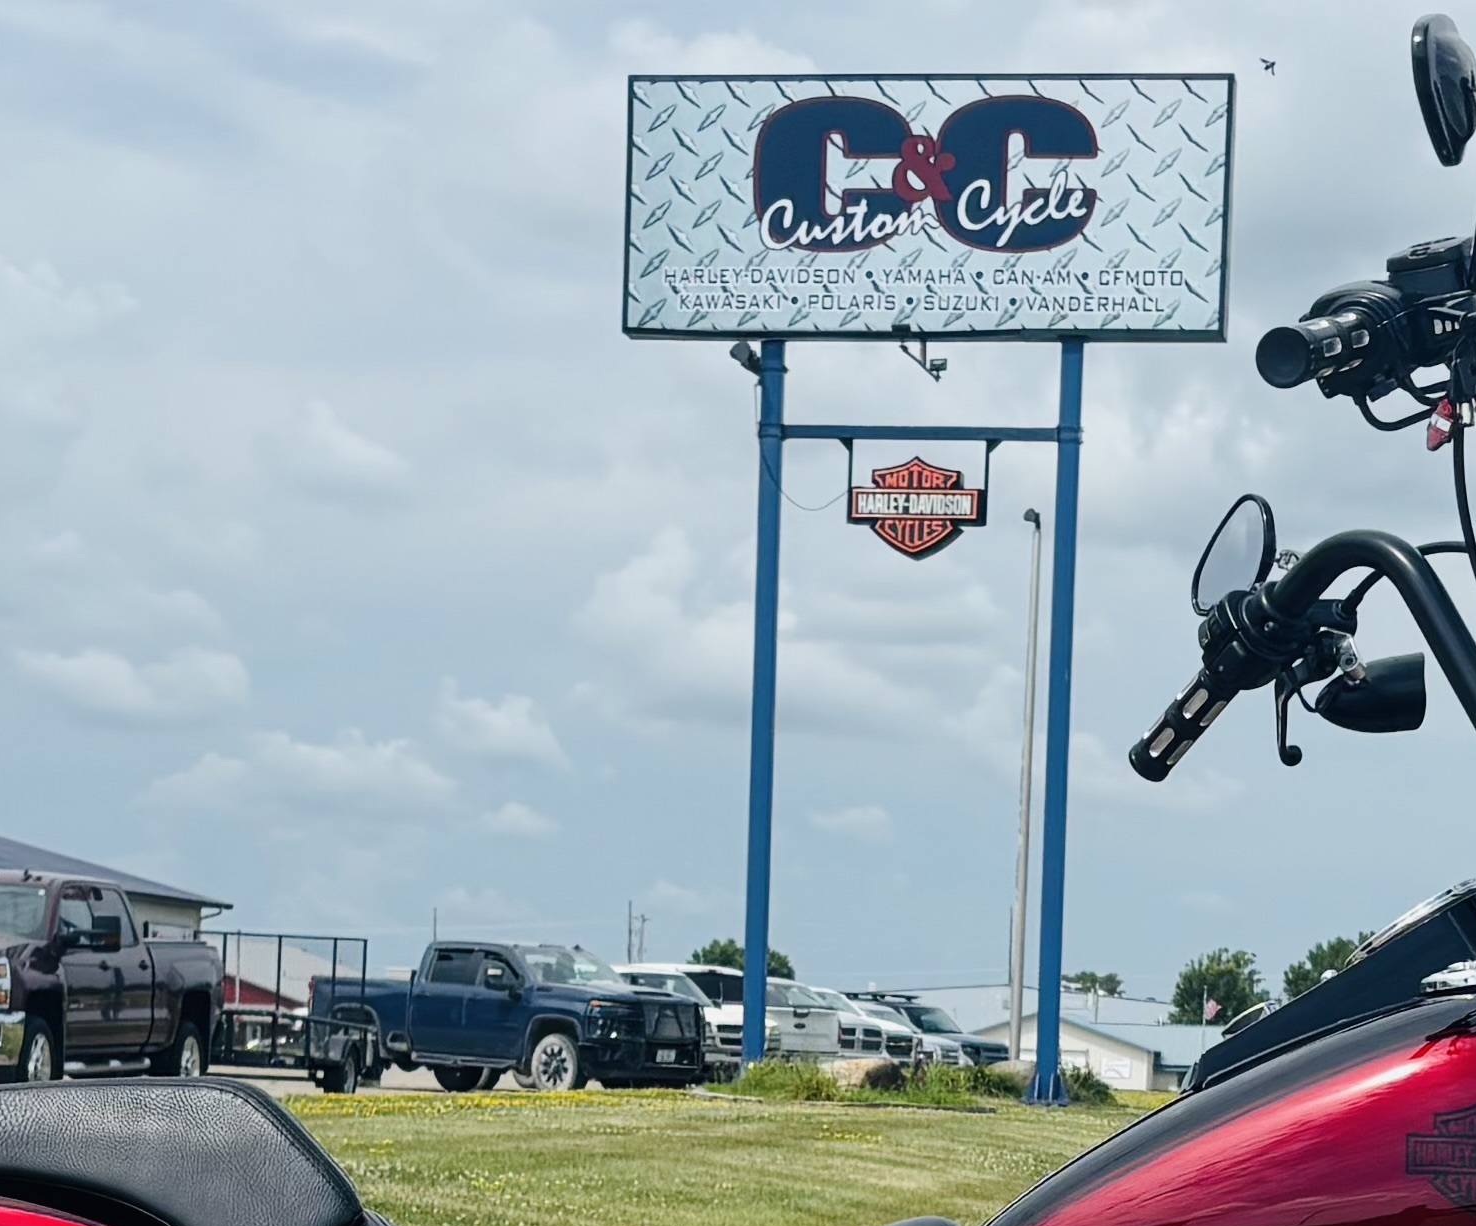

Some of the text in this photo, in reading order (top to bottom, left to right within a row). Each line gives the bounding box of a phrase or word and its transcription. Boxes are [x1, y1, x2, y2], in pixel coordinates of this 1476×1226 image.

[753, 95, 1099, 253] C&C
[760, 170, 1088, 250] Custom Cycle
[663, 267, 856, 285] HARLEY-DAVIDSON
[882, 268, 966, 286] YAMAHA
[1098, 269, 1184, 287] CFMOTO
[678, 294, 1165, 313] KAWASAKI POLARIS SUZUKI VANDERHALL
[885, 464, 945, 488] MOTOR
[857, 493, 972, 516] HARLEY-DAVIDSON
[884, 520, 944, 547] CYCLES
